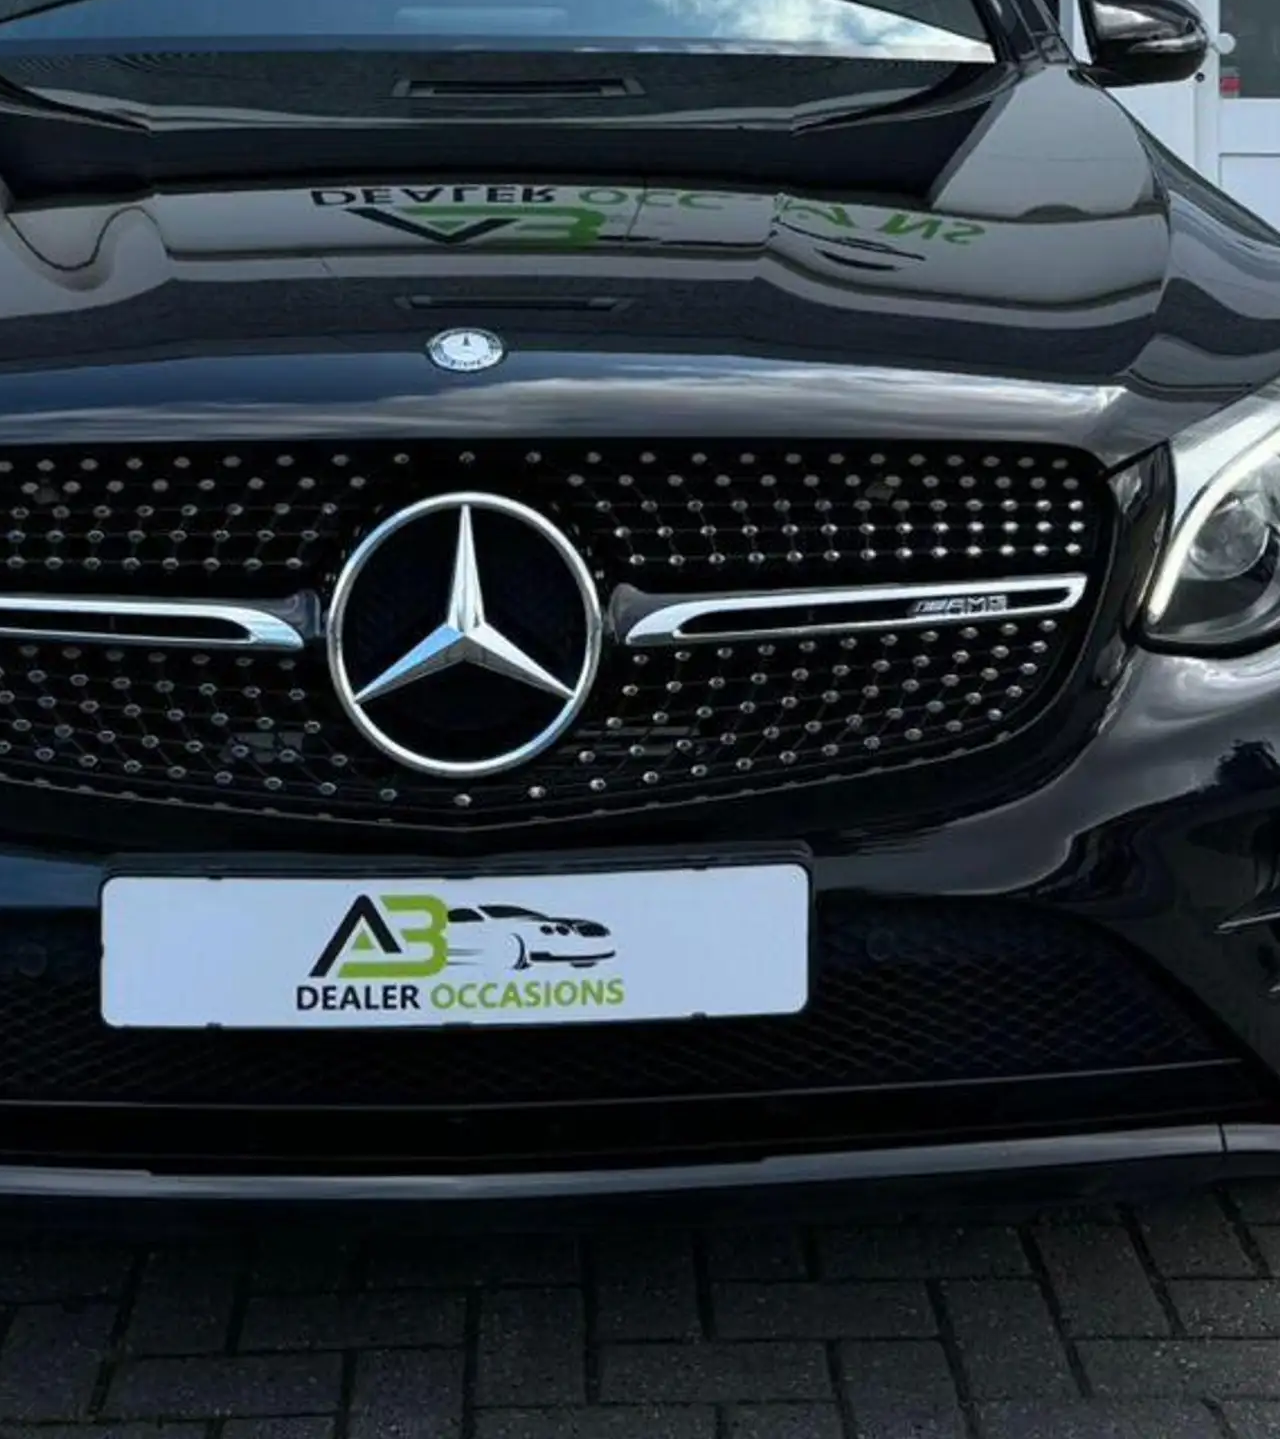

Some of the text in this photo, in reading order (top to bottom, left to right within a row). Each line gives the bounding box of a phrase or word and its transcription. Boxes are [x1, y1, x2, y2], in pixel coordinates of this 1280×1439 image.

[308, 893, 449, 979] AB
[296, 978, 625, 1011] DEALER OCCASIONS
